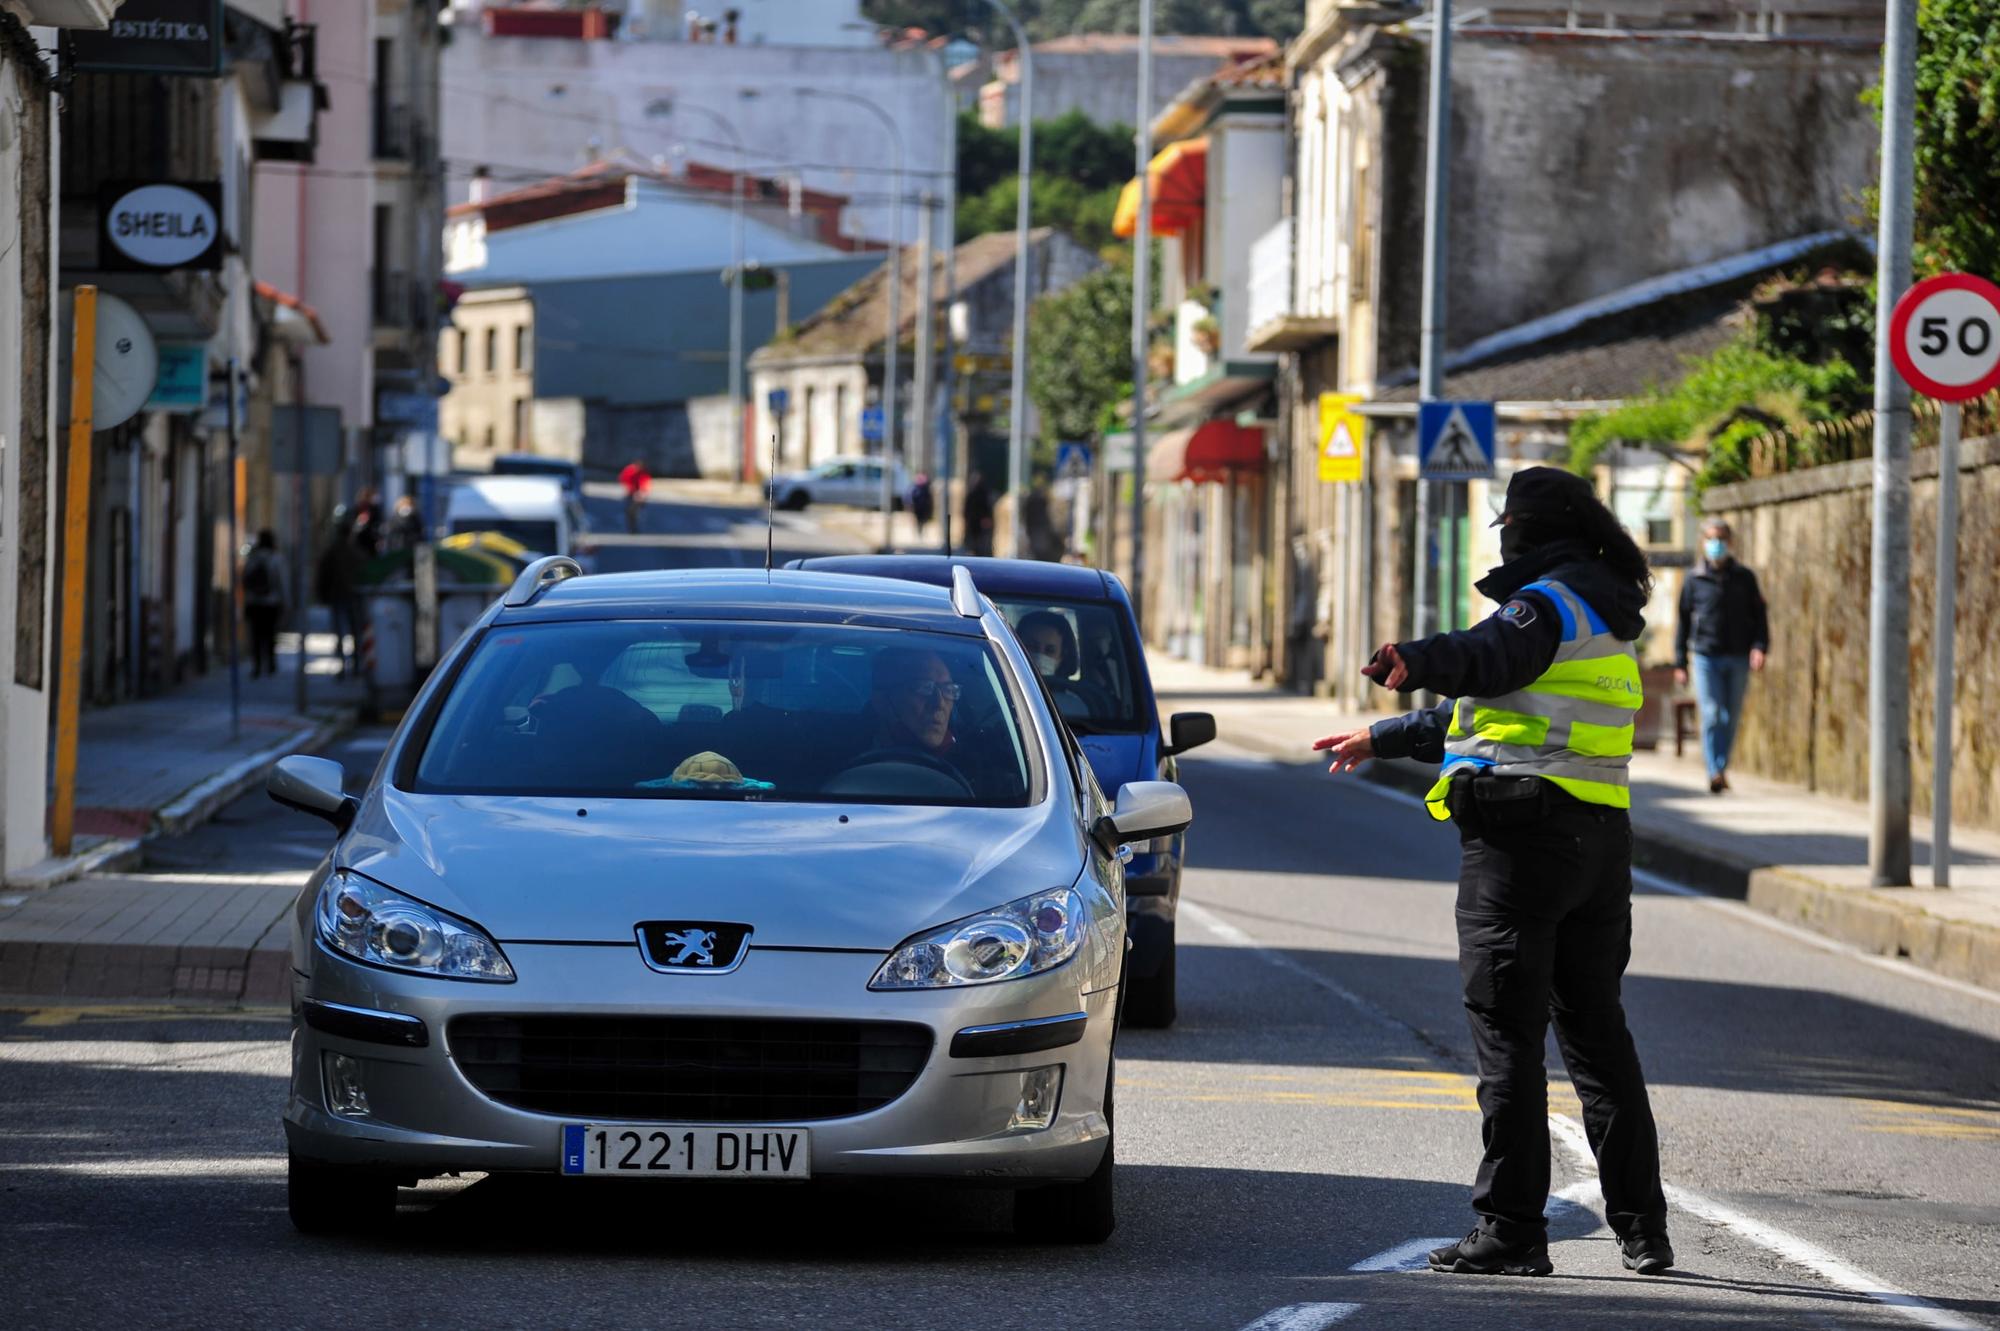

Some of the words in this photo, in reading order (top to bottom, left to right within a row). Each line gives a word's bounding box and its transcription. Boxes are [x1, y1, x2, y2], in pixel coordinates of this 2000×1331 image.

[112, 18, 209, 41] ESTÉTICA
[116, 210, 208, 238] SHEILA
[1920, 316, 1991, 357] 50
[569, 1155, 579, 1167] E
[595, 1130, 695, 1171] 1221
[716, 1132, 798, 1172] DHV
